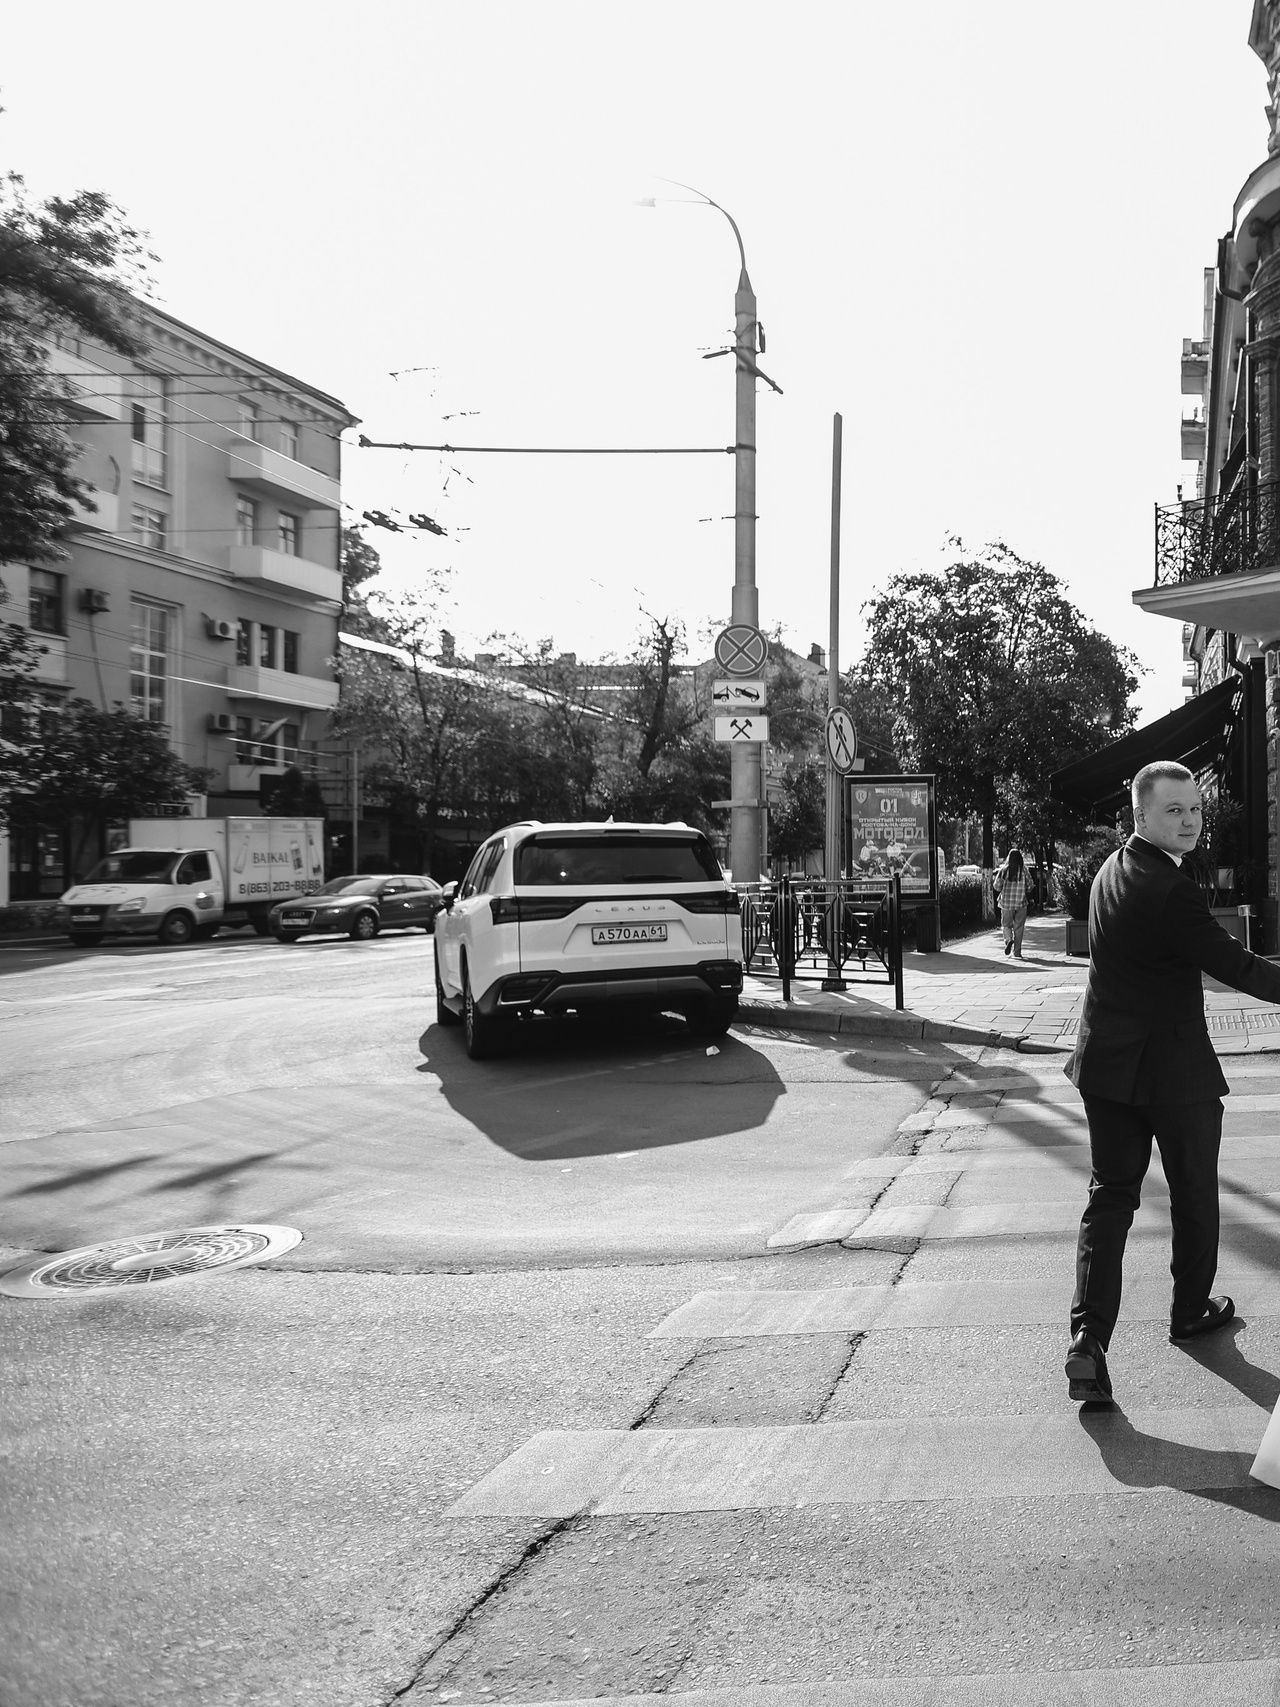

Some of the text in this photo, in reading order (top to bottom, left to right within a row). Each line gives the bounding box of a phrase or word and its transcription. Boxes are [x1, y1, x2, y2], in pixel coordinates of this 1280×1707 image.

[880, 798, 898, 813] 01
[854, 827, 924, 839] МОТОБОЛ
[252, 851, 290, 864] BAIKAL
[650, 926, 664, 936] 61
